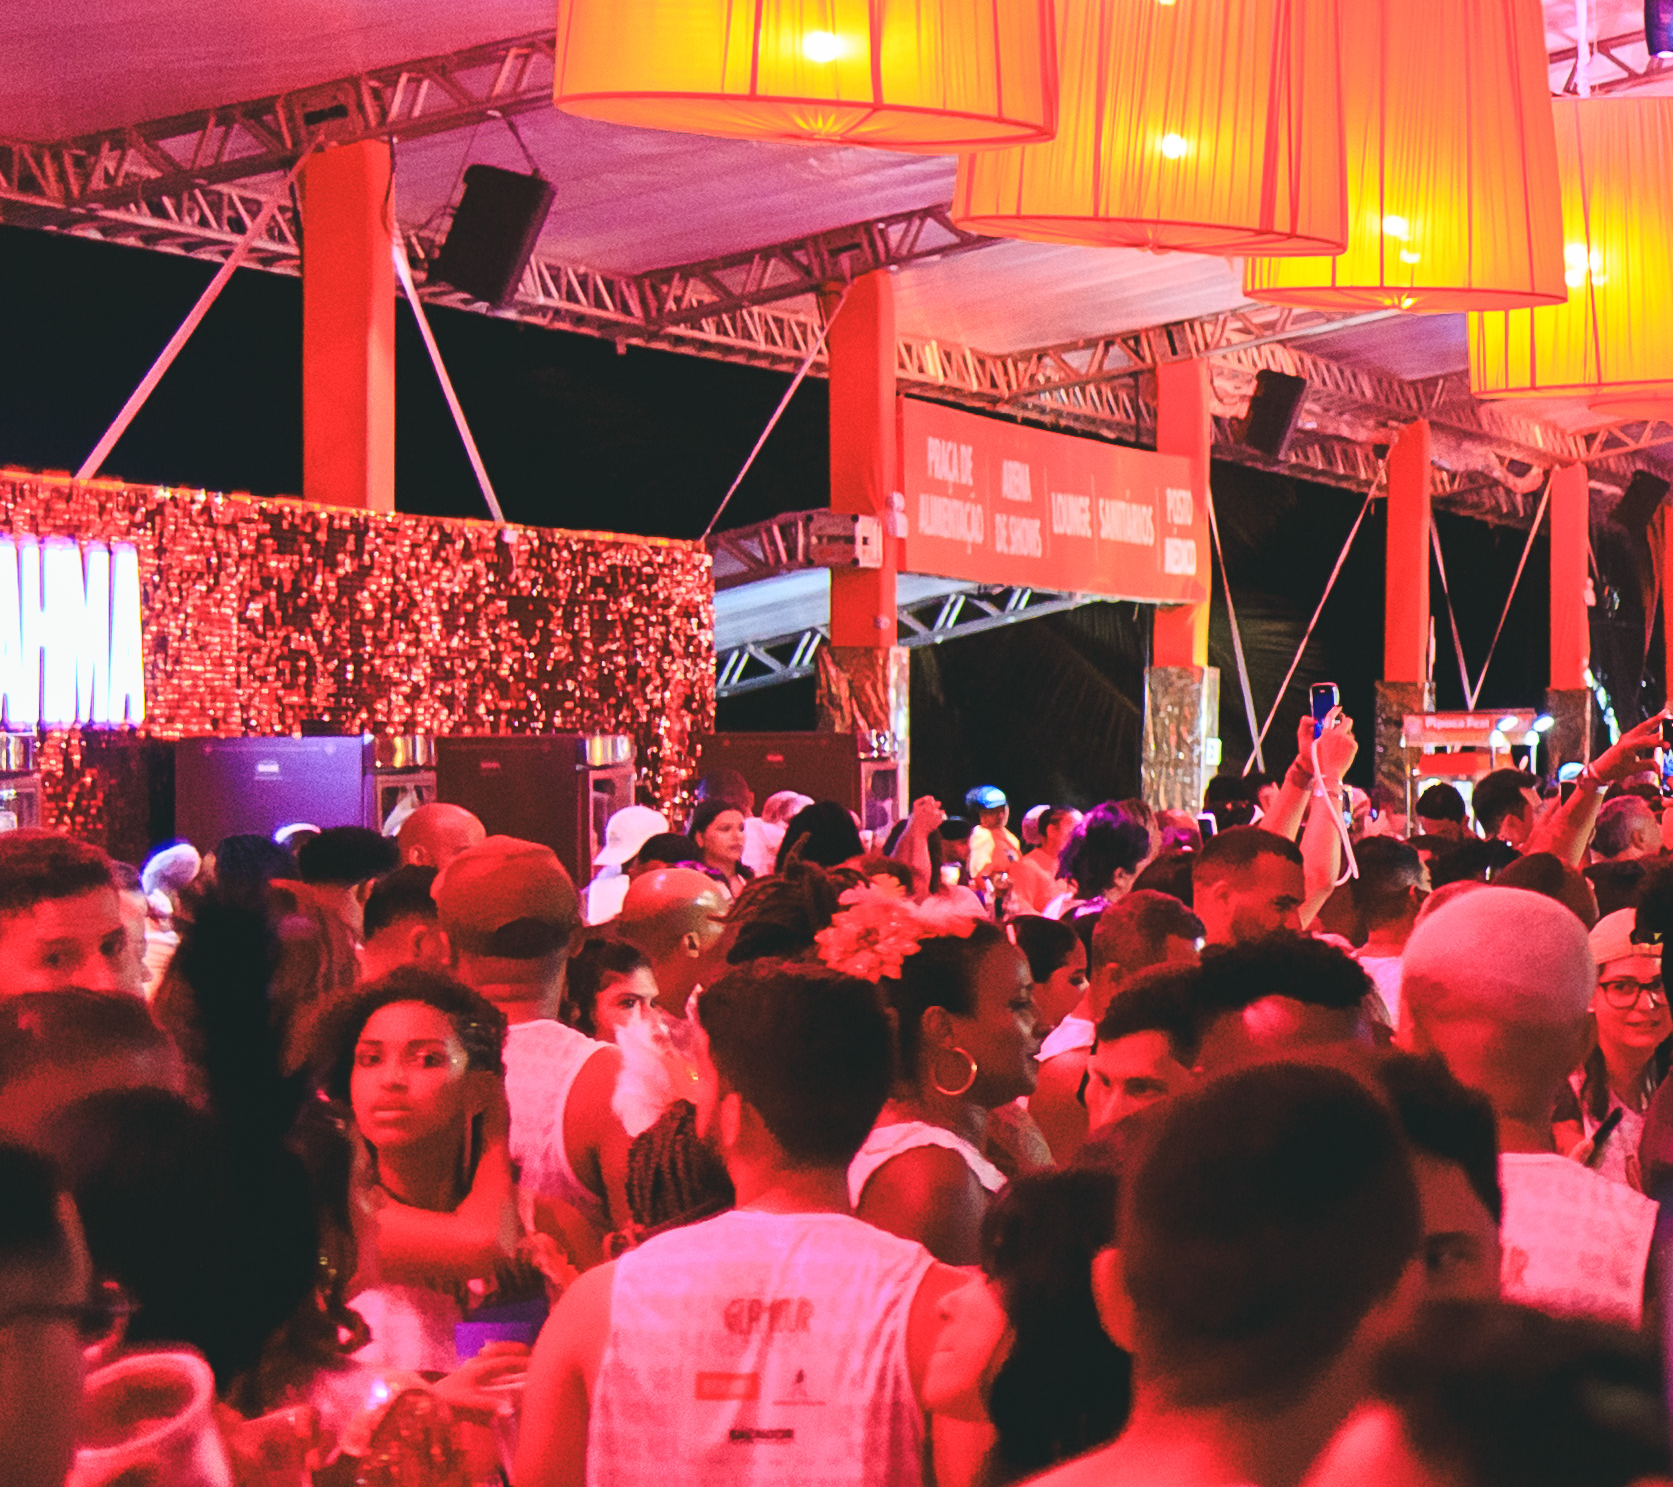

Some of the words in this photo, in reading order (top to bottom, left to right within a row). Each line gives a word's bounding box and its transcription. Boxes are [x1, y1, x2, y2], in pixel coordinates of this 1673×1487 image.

[959, 444, 974, 487] DE
[1051, 492, 1092, 539] LOUNGE
[1099, 489, 1155, 547] SANITÁRIOS
[1166, 487, 1193, 526] POSTO
